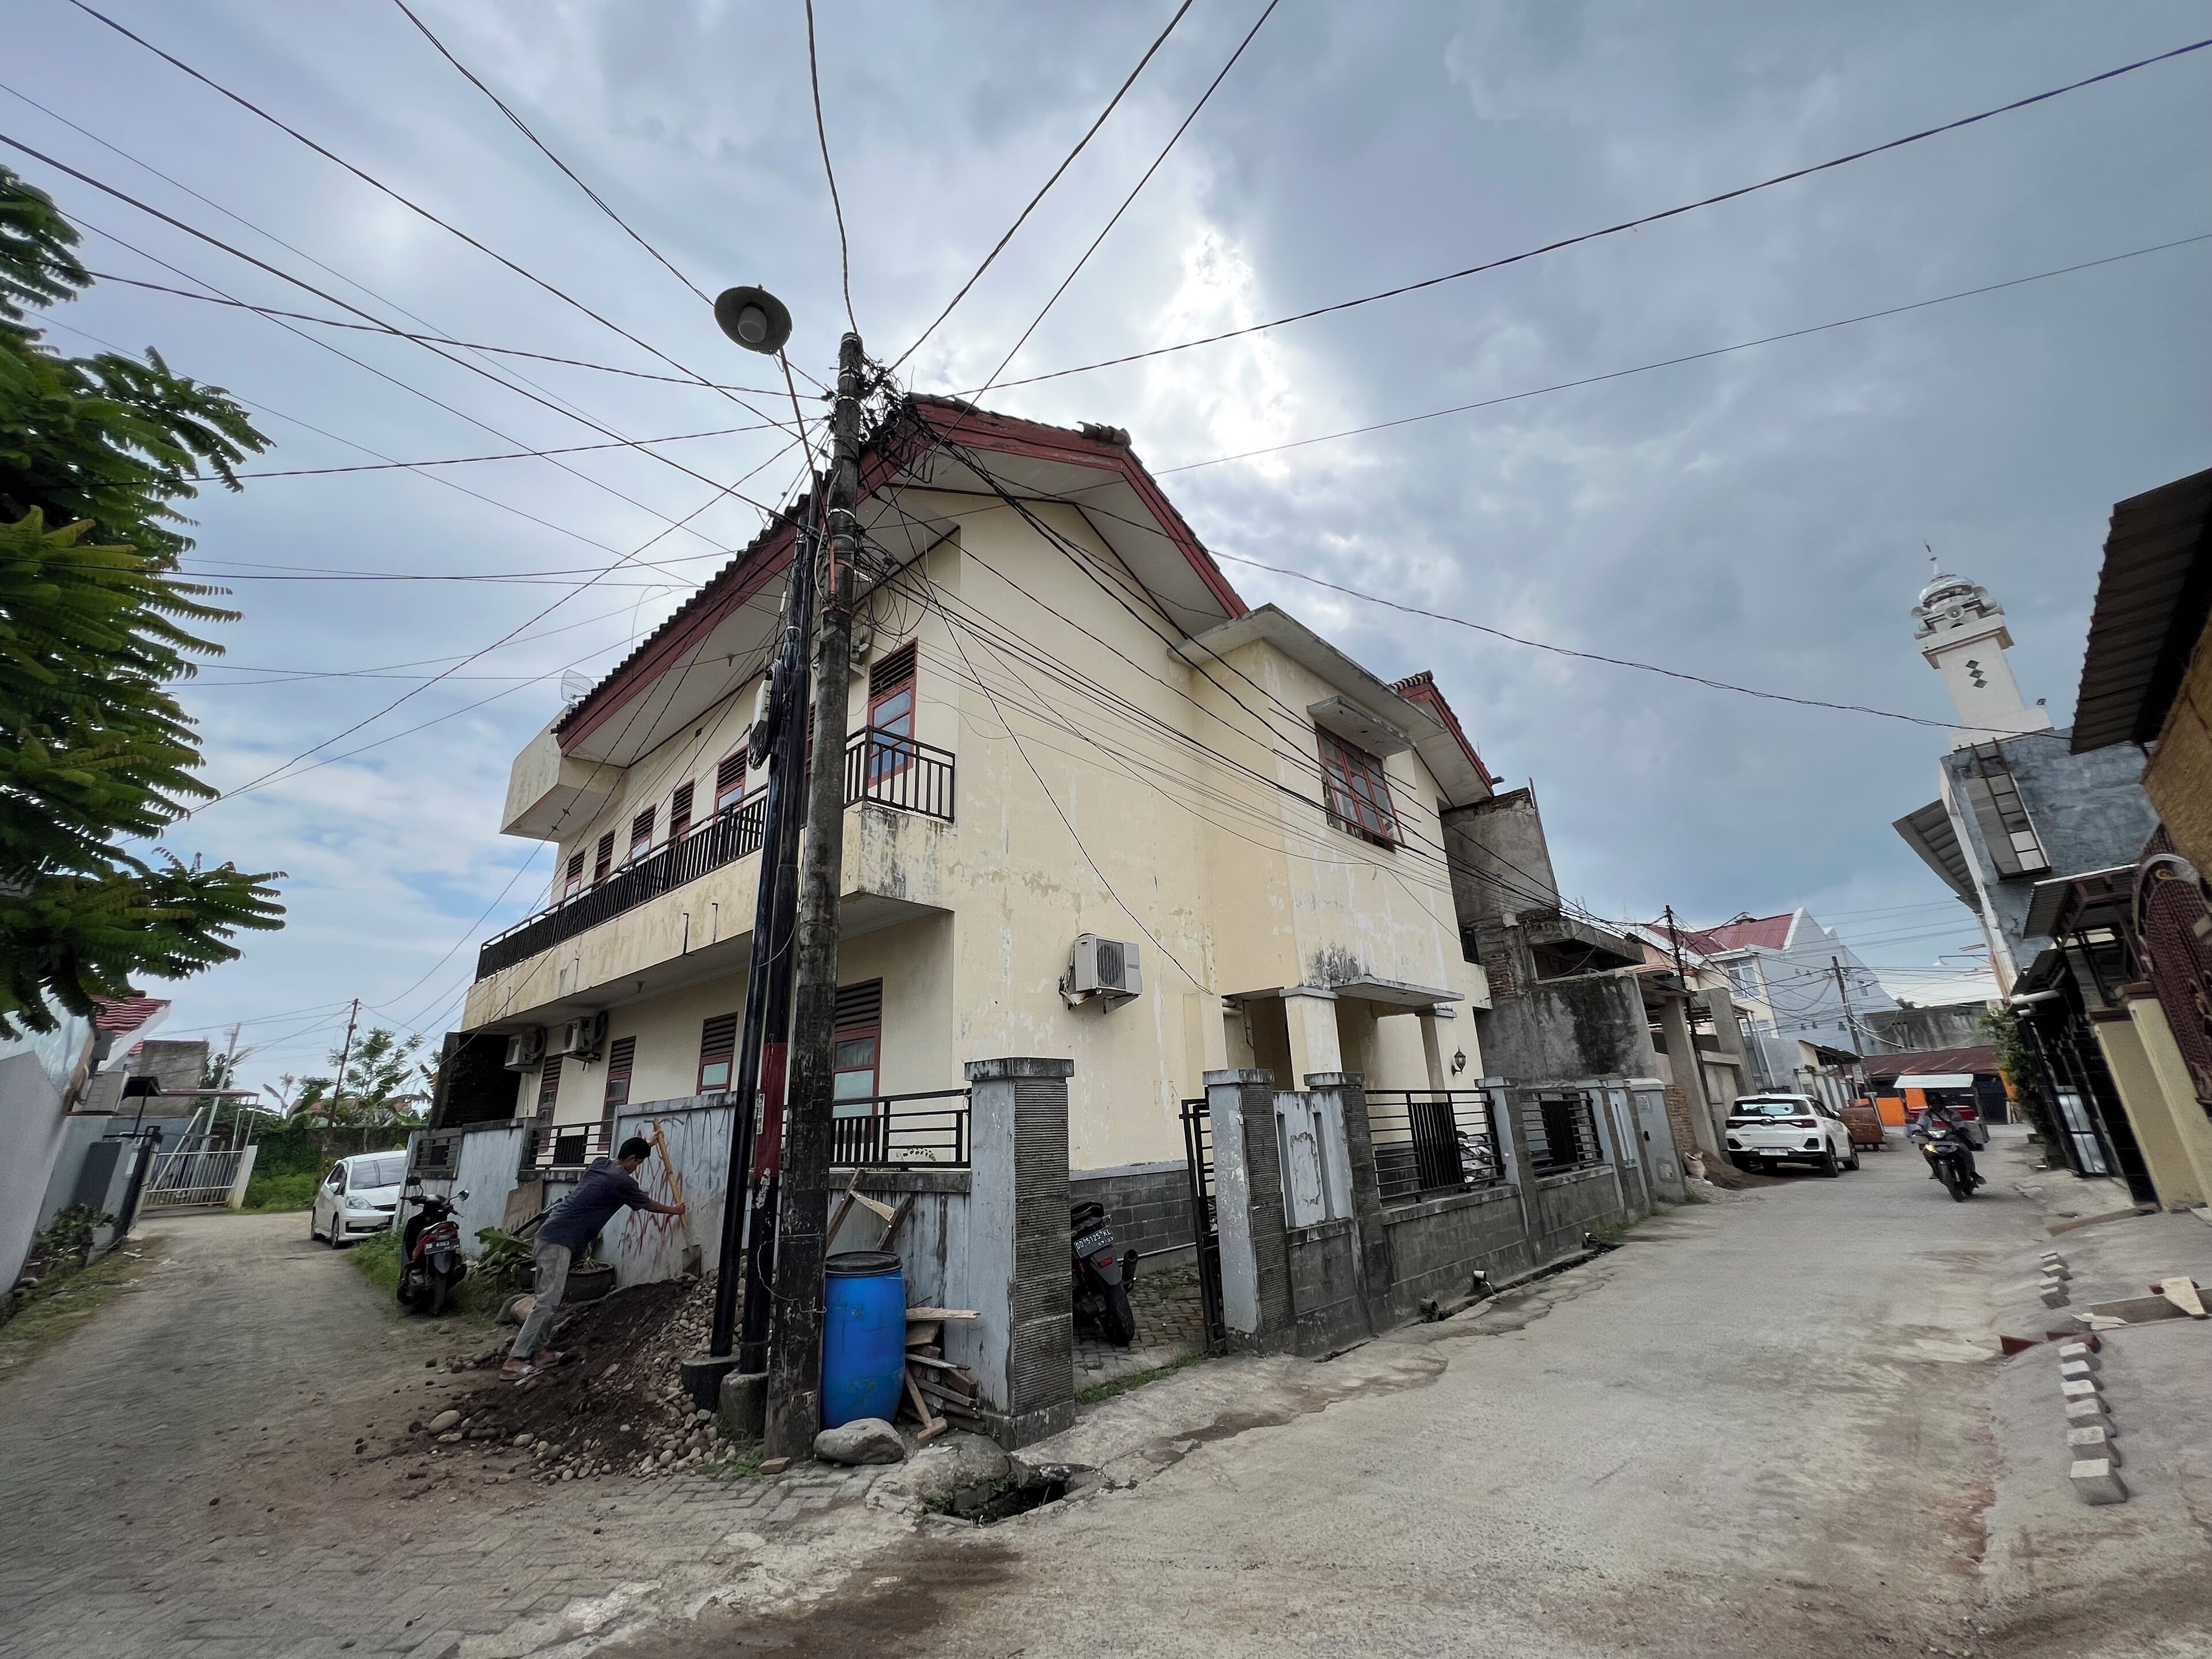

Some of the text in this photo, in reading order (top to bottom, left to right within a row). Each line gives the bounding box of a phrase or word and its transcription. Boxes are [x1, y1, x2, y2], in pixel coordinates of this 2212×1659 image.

[1075, 1228, 1111, 1249] DD 5125 KL
